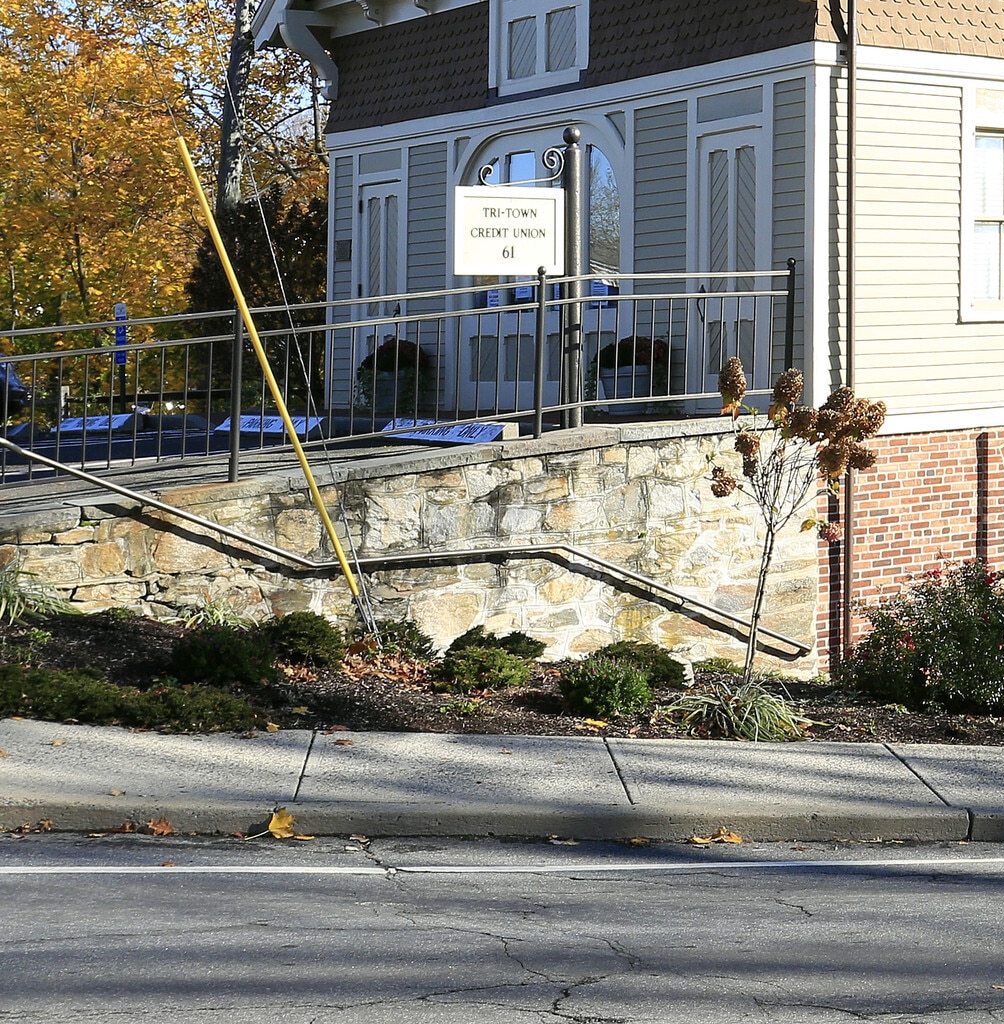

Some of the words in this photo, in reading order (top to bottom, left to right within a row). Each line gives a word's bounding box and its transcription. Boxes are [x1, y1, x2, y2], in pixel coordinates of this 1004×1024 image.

[483, 207, 537, 219] TRI-TOWN
[470, 227, 509, 239] CREDIT
[513, 228, 546, 239] UNION
[502, 246, 515, 259] 61
